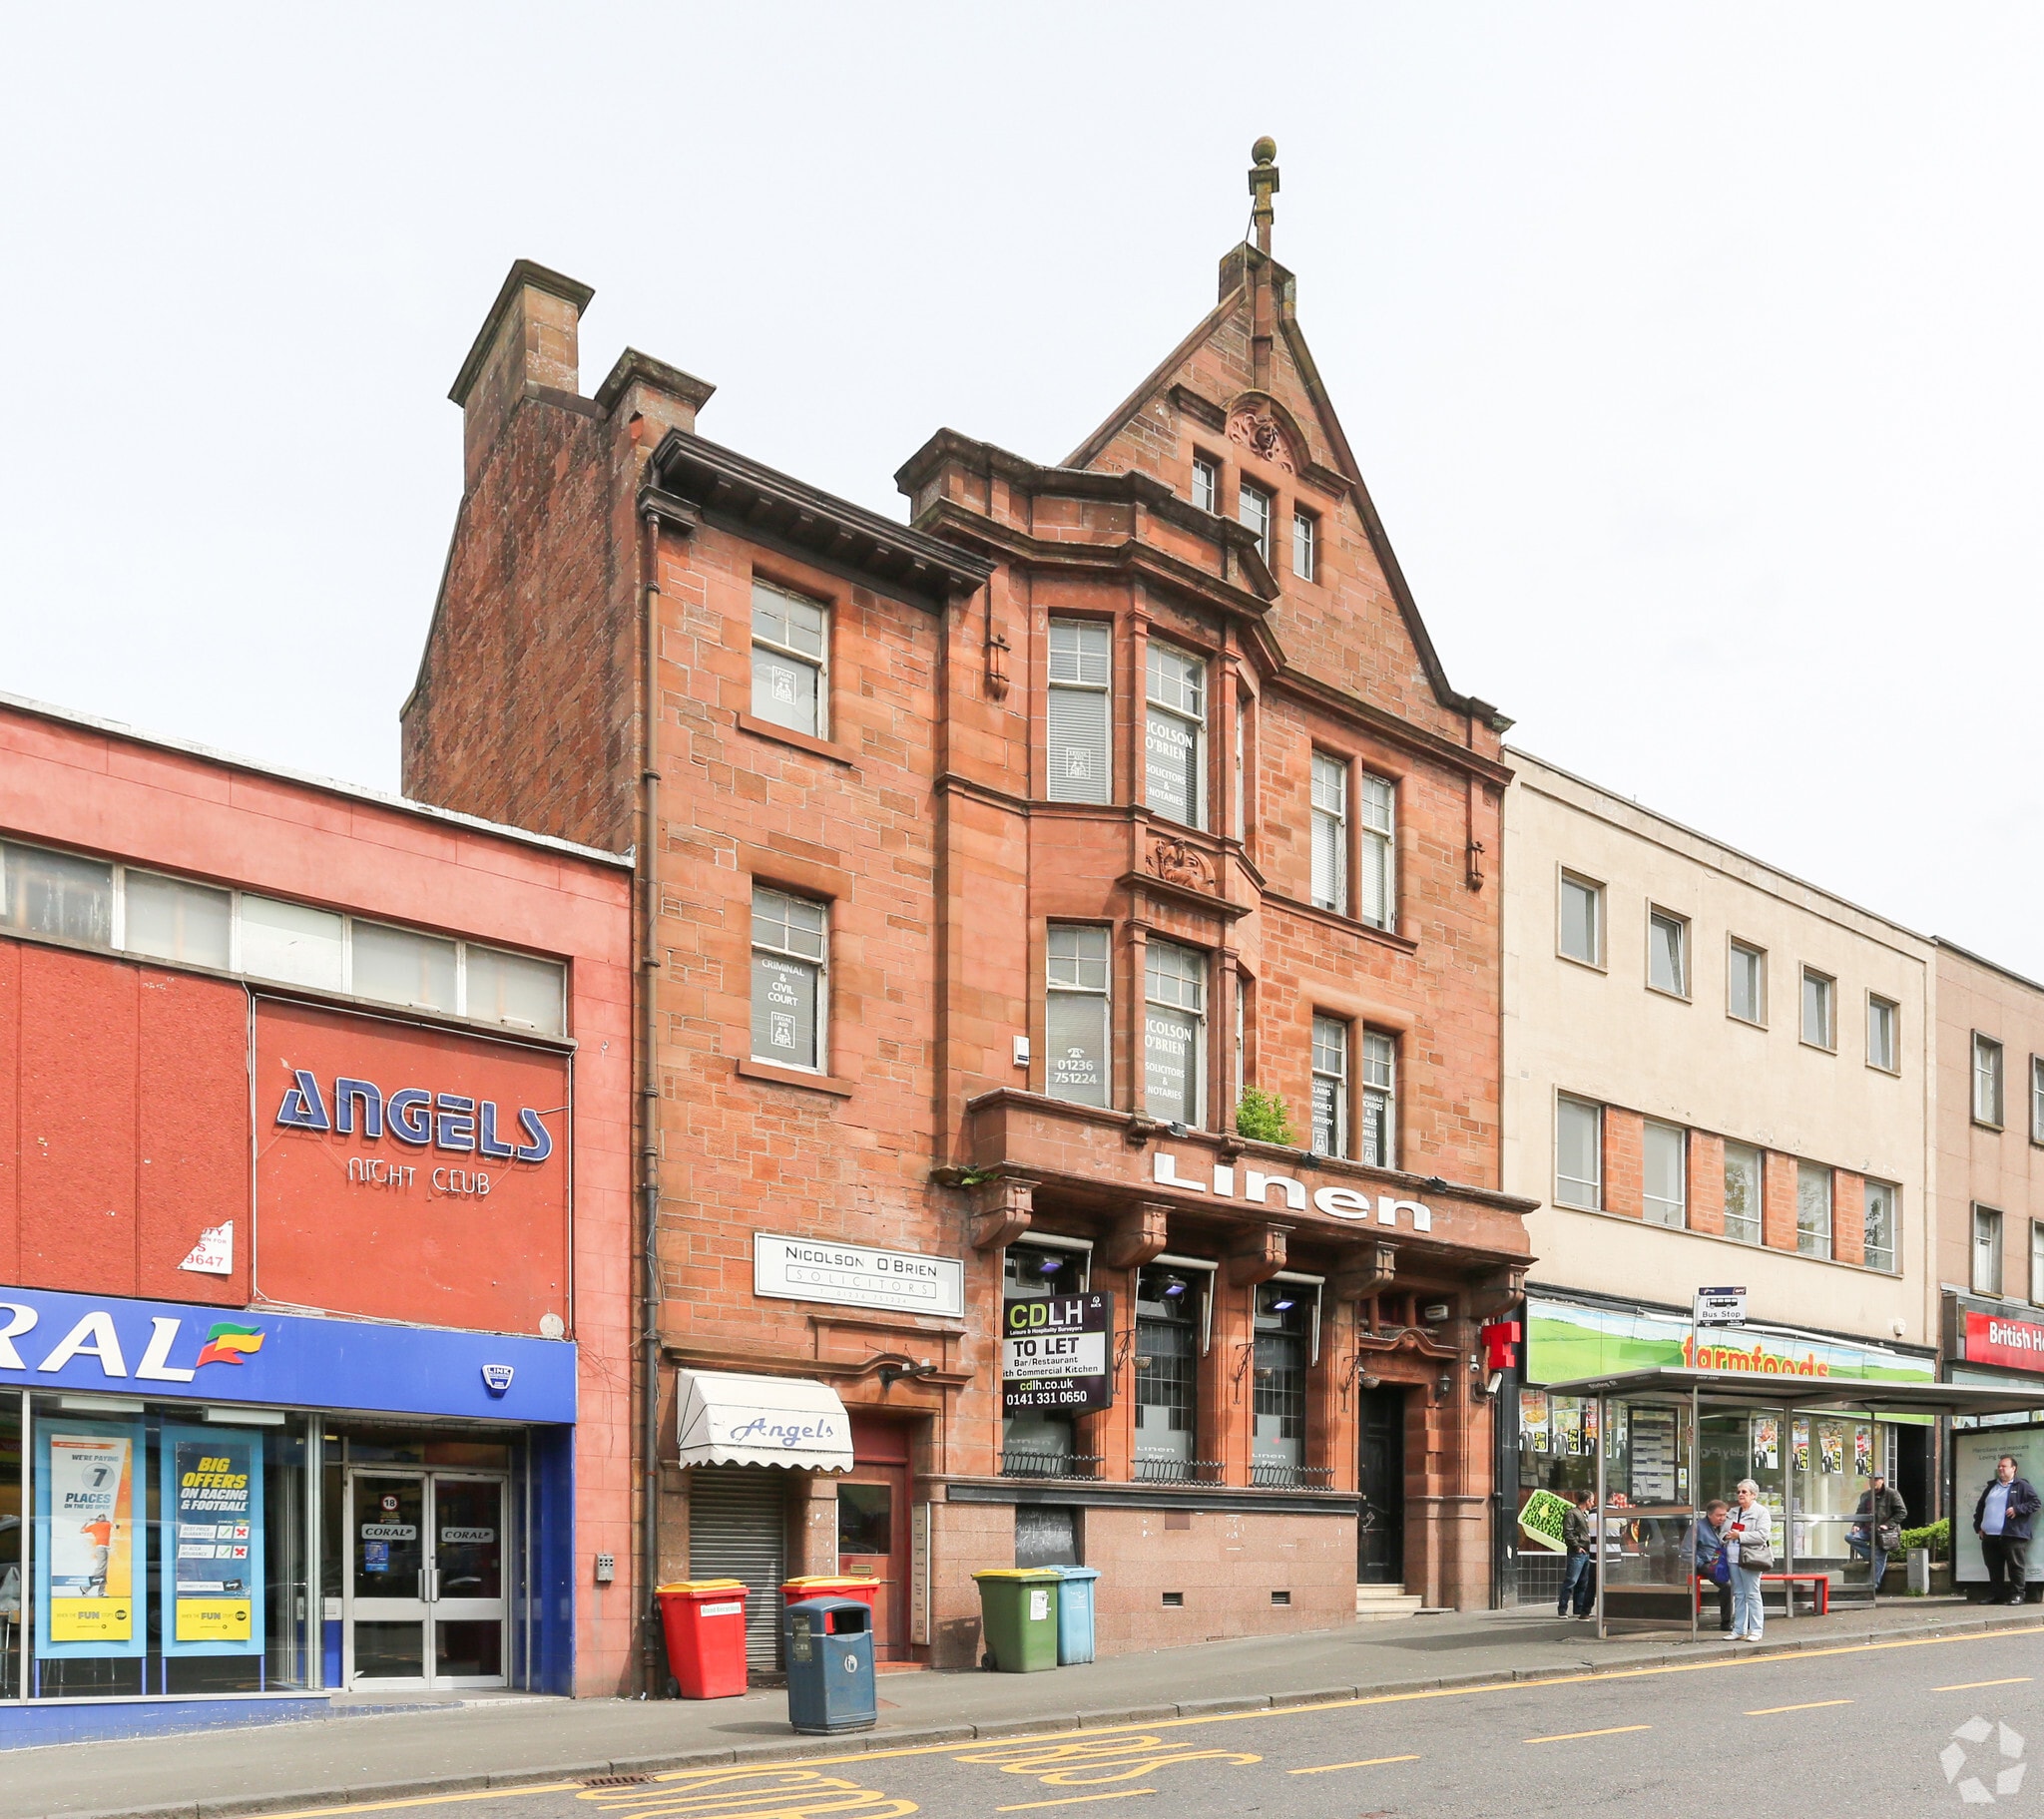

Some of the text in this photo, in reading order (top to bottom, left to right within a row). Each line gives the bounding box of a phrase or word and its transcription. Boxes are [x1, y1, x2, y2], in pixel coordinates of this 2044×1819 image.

[1145, 736, 1186, 761] O'BRIEN
[1146, 764, 1186, 785] SOLICITORS
[1164, 781, 1170, 790] &
[1149, 786, 1184, 806] NOTARIES
[762, 959, 804, 976] CRIMINAL
[779, 973, 786, 983] &
[771, 982, 794, 995] CIVIL
[767, 992, 798, 1007] COURT
[773, 1015, 792, 1024] LEGAL
[1145, 1035, 1185, 1056] O'BRIEN
[1058, 1060, 1094, 1071] 01236
[1145, 1062, 1185, 1079] SOLICITORS
[1054, 1073, 1097, 1085] 751224
[1162, 1077, 1168, 1086] &
[1147, 1085, 1183, 1100] NOTARIES
[276, 1069, 553, 1162] ANGELS
[348, 1156, 490, 1194] NIGHT CLUB
[1154, 1151, 1432, 1233] Linen
[796, 1269, 927, 1295] SOLICITORS
[1009, 1300, 1083, 1328] CDLH
[1989, 1321, 2031, 1349] British
[1013, 1337, 1080, 1357] TO LET
[1014, 1356, 1078, 1367] Bar/Restaurant
[1016, 1366, 1062, 1376] Commercial
[1065, 1365, 1098, 1374] Kitchen
[1019, 1378, 1074, 1391] cdlh.co.uk
[1006, 1390, 1088, 1406] 0141 331 0650
[730, 1418, 833, 1447] Angels
[197, 1457, 231, 1472] BIG
[93, 1468, 108, 1487] 7
[182, 1472, 249, 1489] OFFERS
[65, 1493, 111, 1504] PLACES
[180, 1488, 249, 1501] ON RACING
[181, 1500, 248, 1512] & FOOTBALL
[365, 1528, 406, 1537] CORAL
